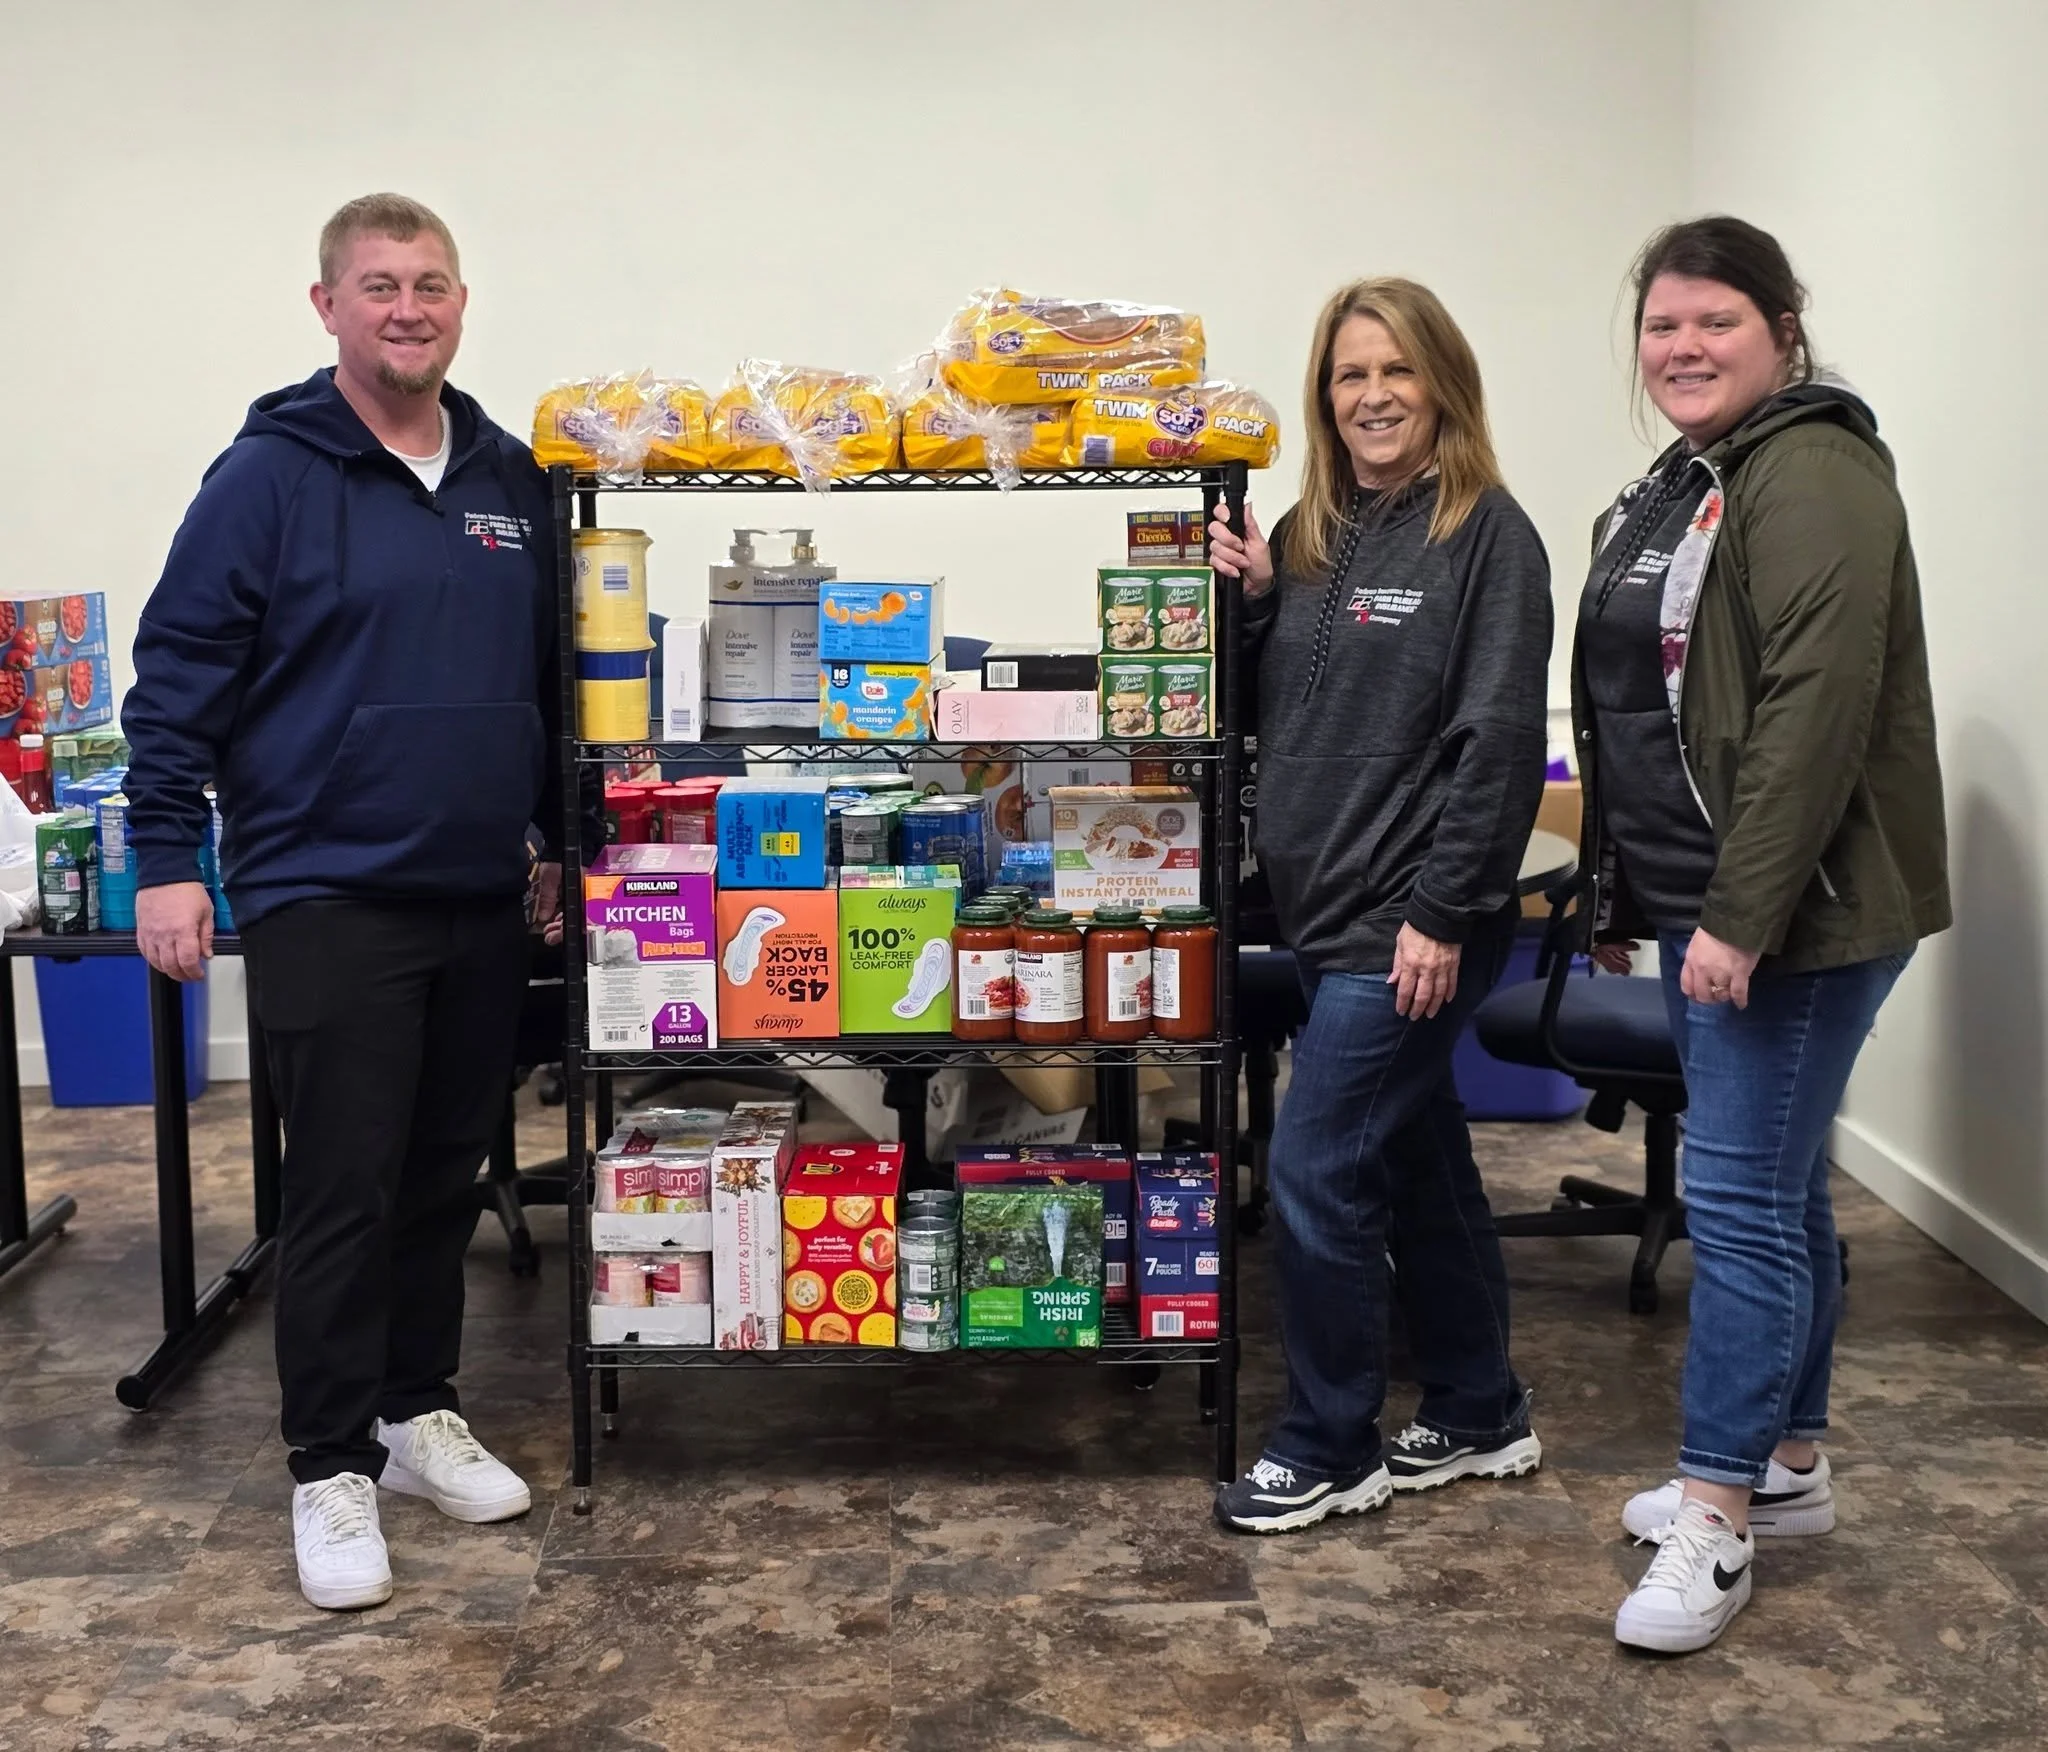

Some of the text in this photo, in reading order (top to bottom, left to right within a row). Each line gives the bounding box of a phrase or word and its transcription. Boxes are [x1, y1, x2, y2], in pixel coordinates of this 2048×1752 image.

[1037, 372, 1155, 389] TWIN PACK
[1093, 399, 1149, 419] TWIN
[1158, 410, 1204, 428] SOFT
[1214, 416, 1269, 438] PACK
[1137, 532, 1172, 544] Cheerios
[753, 576, 795, 587] intensive
[725, 630, 750, 640] Dove
[791, 629, 815, 640] Dove
[725, 642, 758, 650] intensive
[790, 641, 819, 649] intensiv
[725, 650, 747, 658] repair
[790, 650, 812, 658] repair
[865, 686, 884, 696] Dole
[853, 705, 896, 715] mandarin
[856, 715, 893, 725] oranges
[952, 700, 962, 734] OLAY
[736, 801, 745, 879] ABSORBENCY
[745, 824, 753, 855] PACK
[626, 881, 678, 891] KIRKLAND
[1096, 876, 1159, 886] PROTEIN
[1061, 887, 1195, 898] INSTANT OATMEAL
[878, 894, 927, 913] always
[605, 905, 686, 923] KITCHEN
[669, 927, 695, 938] Bags
[848, 927, 915, 950] 100%
[766, 947, 828, 962] BACK
[850, 951, 914, 960] LEAK-FREE
[766, 965, 828, 976] LARGER
[852, 960, 912, 970] COMFORT
[766, 979, 829, 1003] 45%
[667, 1005, 692, 1022] 13
[754, 1014, 803, 1033] always
[659, 1034, 703, 1045] 200 BAGS
[623, 1169, 653, 1186] sim
[1148, 1195, 1180, 1210] Ready
[1151, 1206, 1176, 1217] Pasta
[1150, 1219, 1178, 1228] Barilla
[738, 1200, 751, 1304] HAPPY & JOYFUL
[1144, 1257, 1158, 1276] 7
[1198, 1259, 1213, 1268] 60
[1032, 1291, 1091, 1305] SPRING
[1040, 1307, 1083, 1321] IRISH
[1189, 1321, 1220, 1329] ROTIN
[1080, 1337, 1096, 1347] 20
